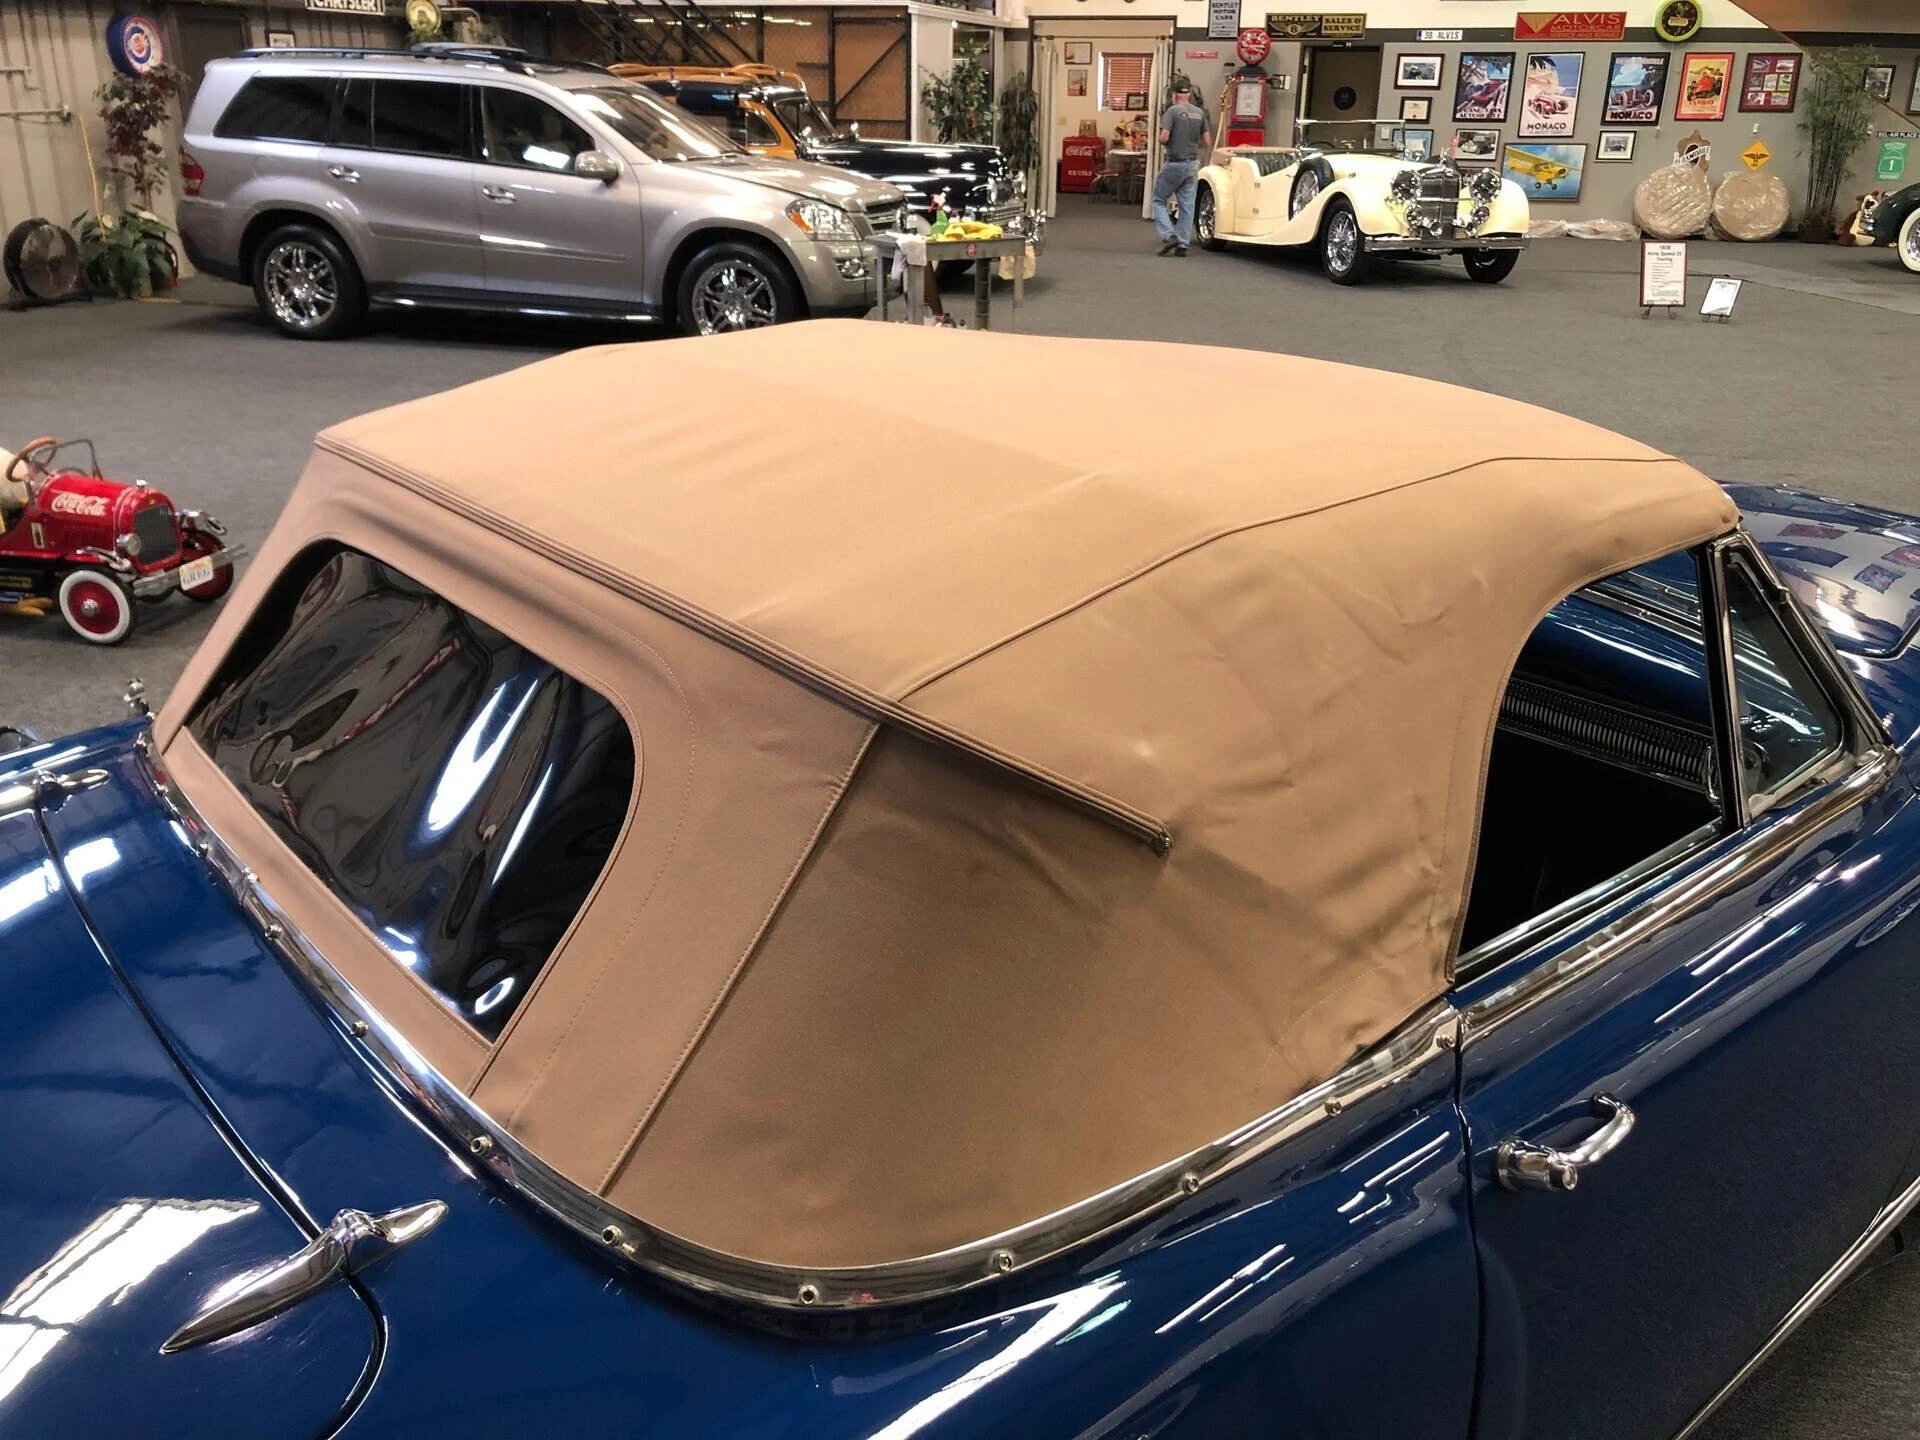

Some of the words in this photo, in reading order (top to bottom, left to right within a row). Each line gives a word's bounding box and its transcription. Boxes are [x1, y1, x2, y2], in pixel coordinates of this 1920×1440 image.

[315, 0, 377, 12] CHRYSLER
[1553, 13, 1621, 25] ALVIS
[1424, 31, 1433, 39] 38
[1438, 31, 1459, 39] ALVIS
[1609, 111, 1653, 120] MONACO
[1526, 122, 1567, 130] MONACO
[1889, 159, 1894, 171] 1
[51, 493, 110, 517] Coca-Cola
